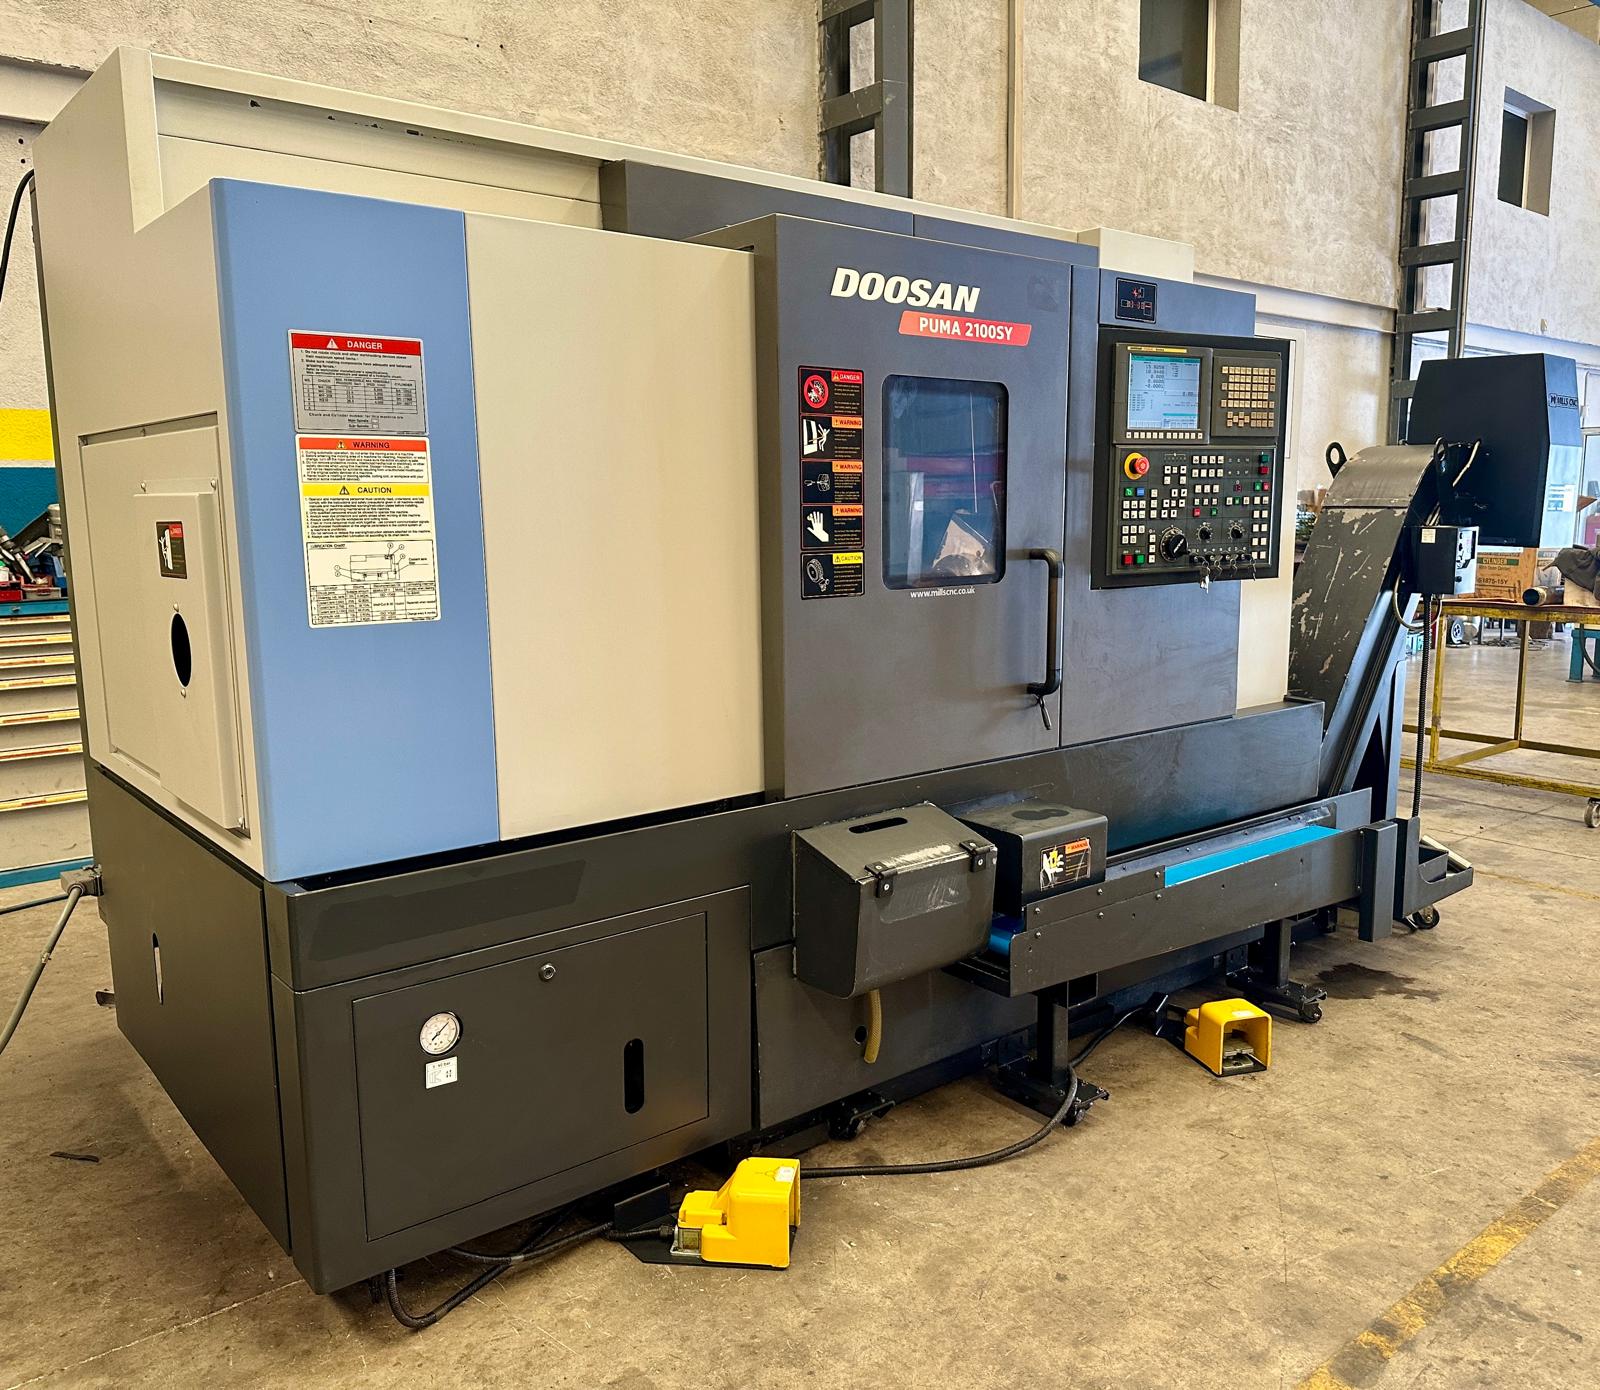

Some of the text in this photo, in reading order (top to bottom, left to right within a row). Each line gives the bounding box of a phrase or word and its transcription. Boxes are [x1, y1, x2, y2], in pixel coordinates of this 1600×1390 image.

[830, 267, 981, 313] DOOSAN
[919, 317, 1014, 341] PUMA 2100SY
[347, 340, 383, 350] DANGER
[352, 441, 390, 449] WARNING
[910, 586, 976, 598] www.millscnc.co.uk
